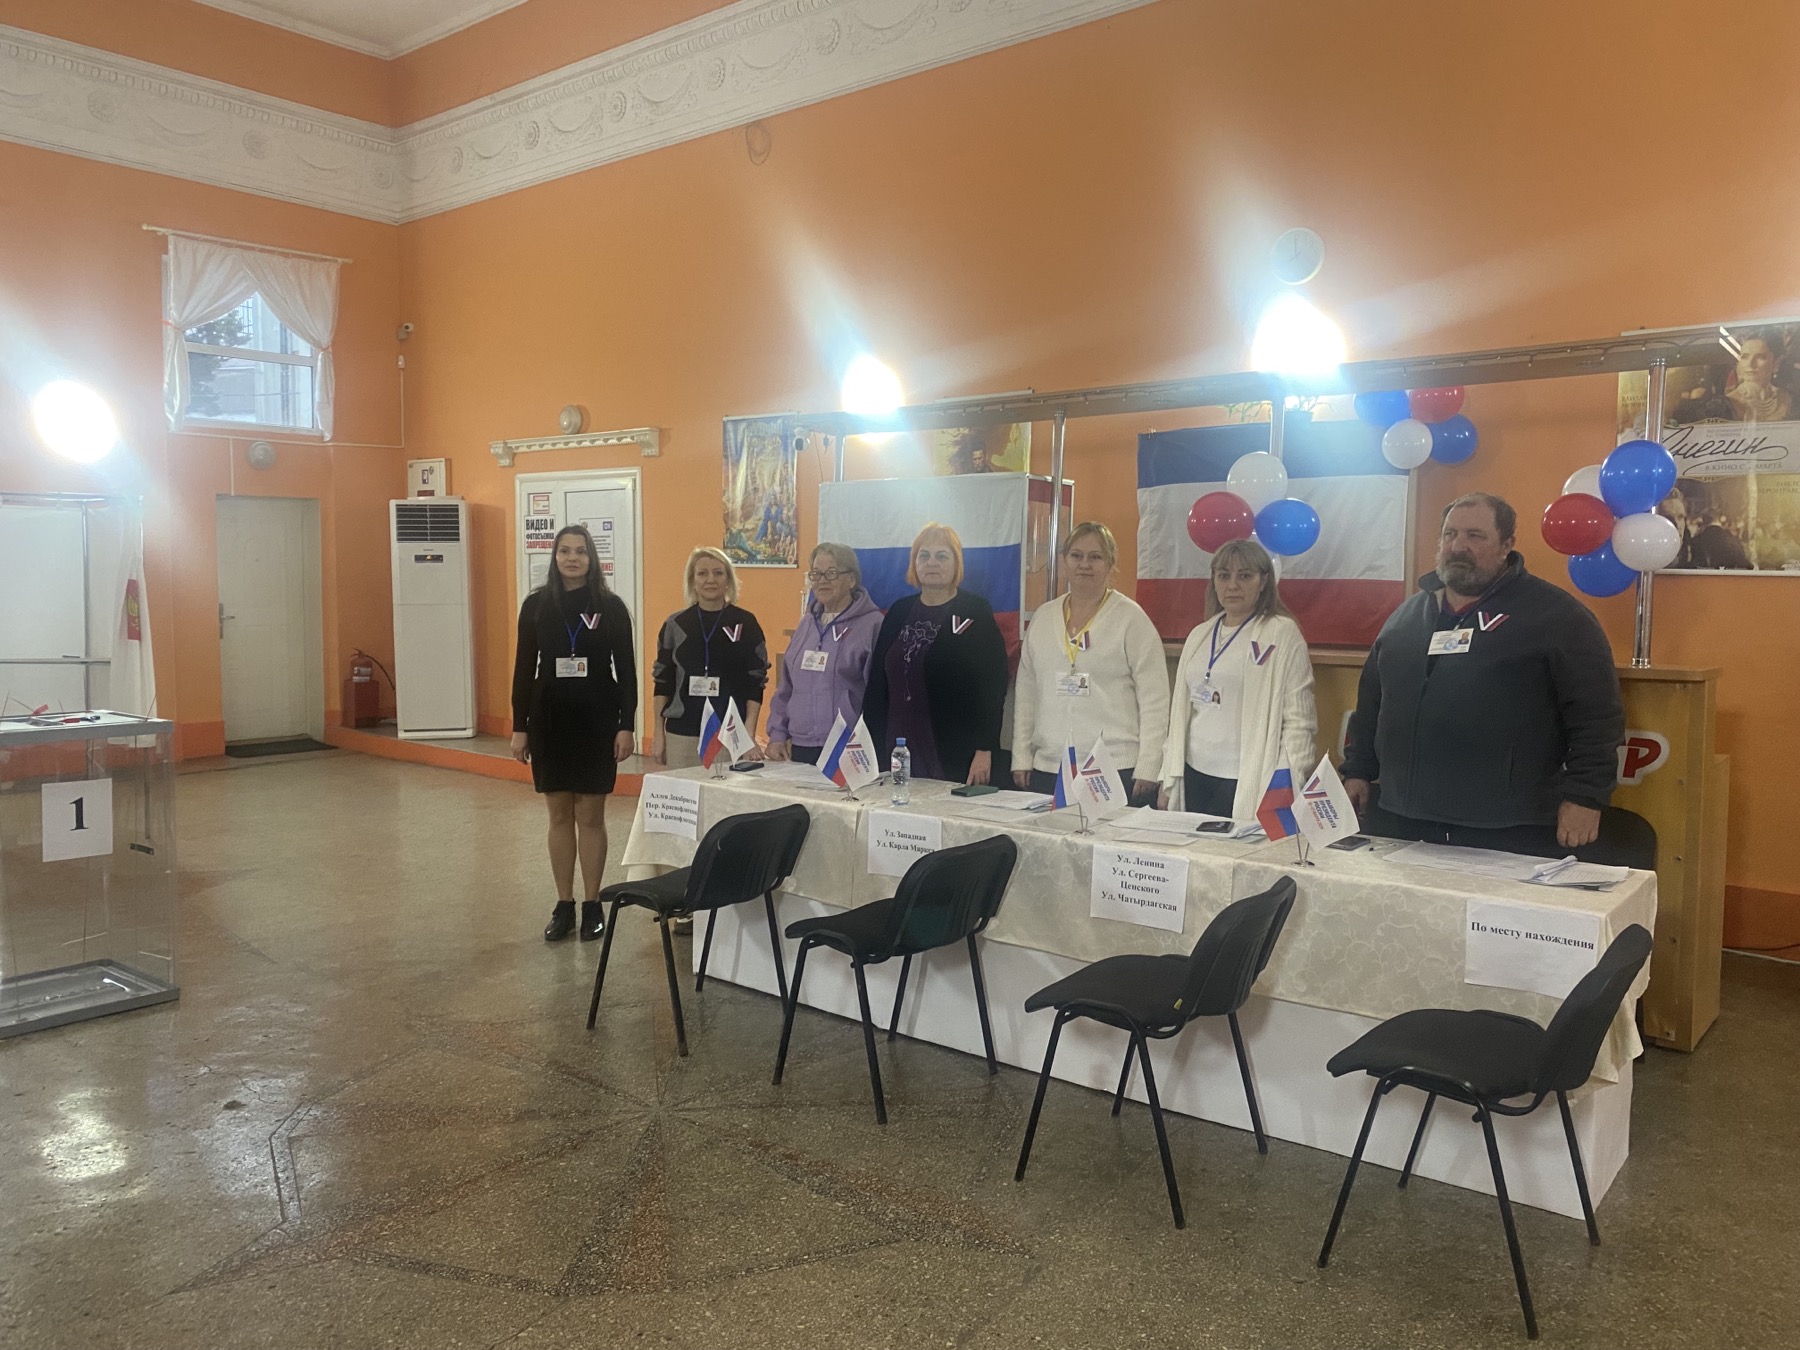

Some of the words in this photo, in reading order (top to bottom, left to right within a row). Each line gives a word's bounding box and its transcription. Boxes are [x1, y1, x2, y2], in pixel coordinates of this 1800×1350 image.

[526, 518, 548, 532] ВИДЕО
[550, 518, 554, 530] И
[69, 796, 89, 832] 1
[1313, 801, 1325, 819] РОССИИ
[1319, 800, 1337, 829] ПРЕЗИДЕНТА
[1325, 799, 1340, 820] ВЫБОРЫ
[884, 829, 896, 838] Ул.
[897, 831, 927, 841] Западная
[876, 839, 888, 848] Ул.
[889, 841, 909, 851] Карла
[1117, 854, 1131, 864] Ул.
[1132, 857, 1165, 870] Ленина
[1112, 867, 1126, 877] Ул.
[1128, 869, 1170, 883] Сергеева-
[1120, 880, 1160, 895] Ценского
[1101, 890, 1116, 901] Ул.
[1118, 893, 1178, 912] Чатырдагская
[1471, 921, 1487, 933] По
[1490, 926, 1522, 940] месту
[1525, 931, 1595, 950] нахождения
